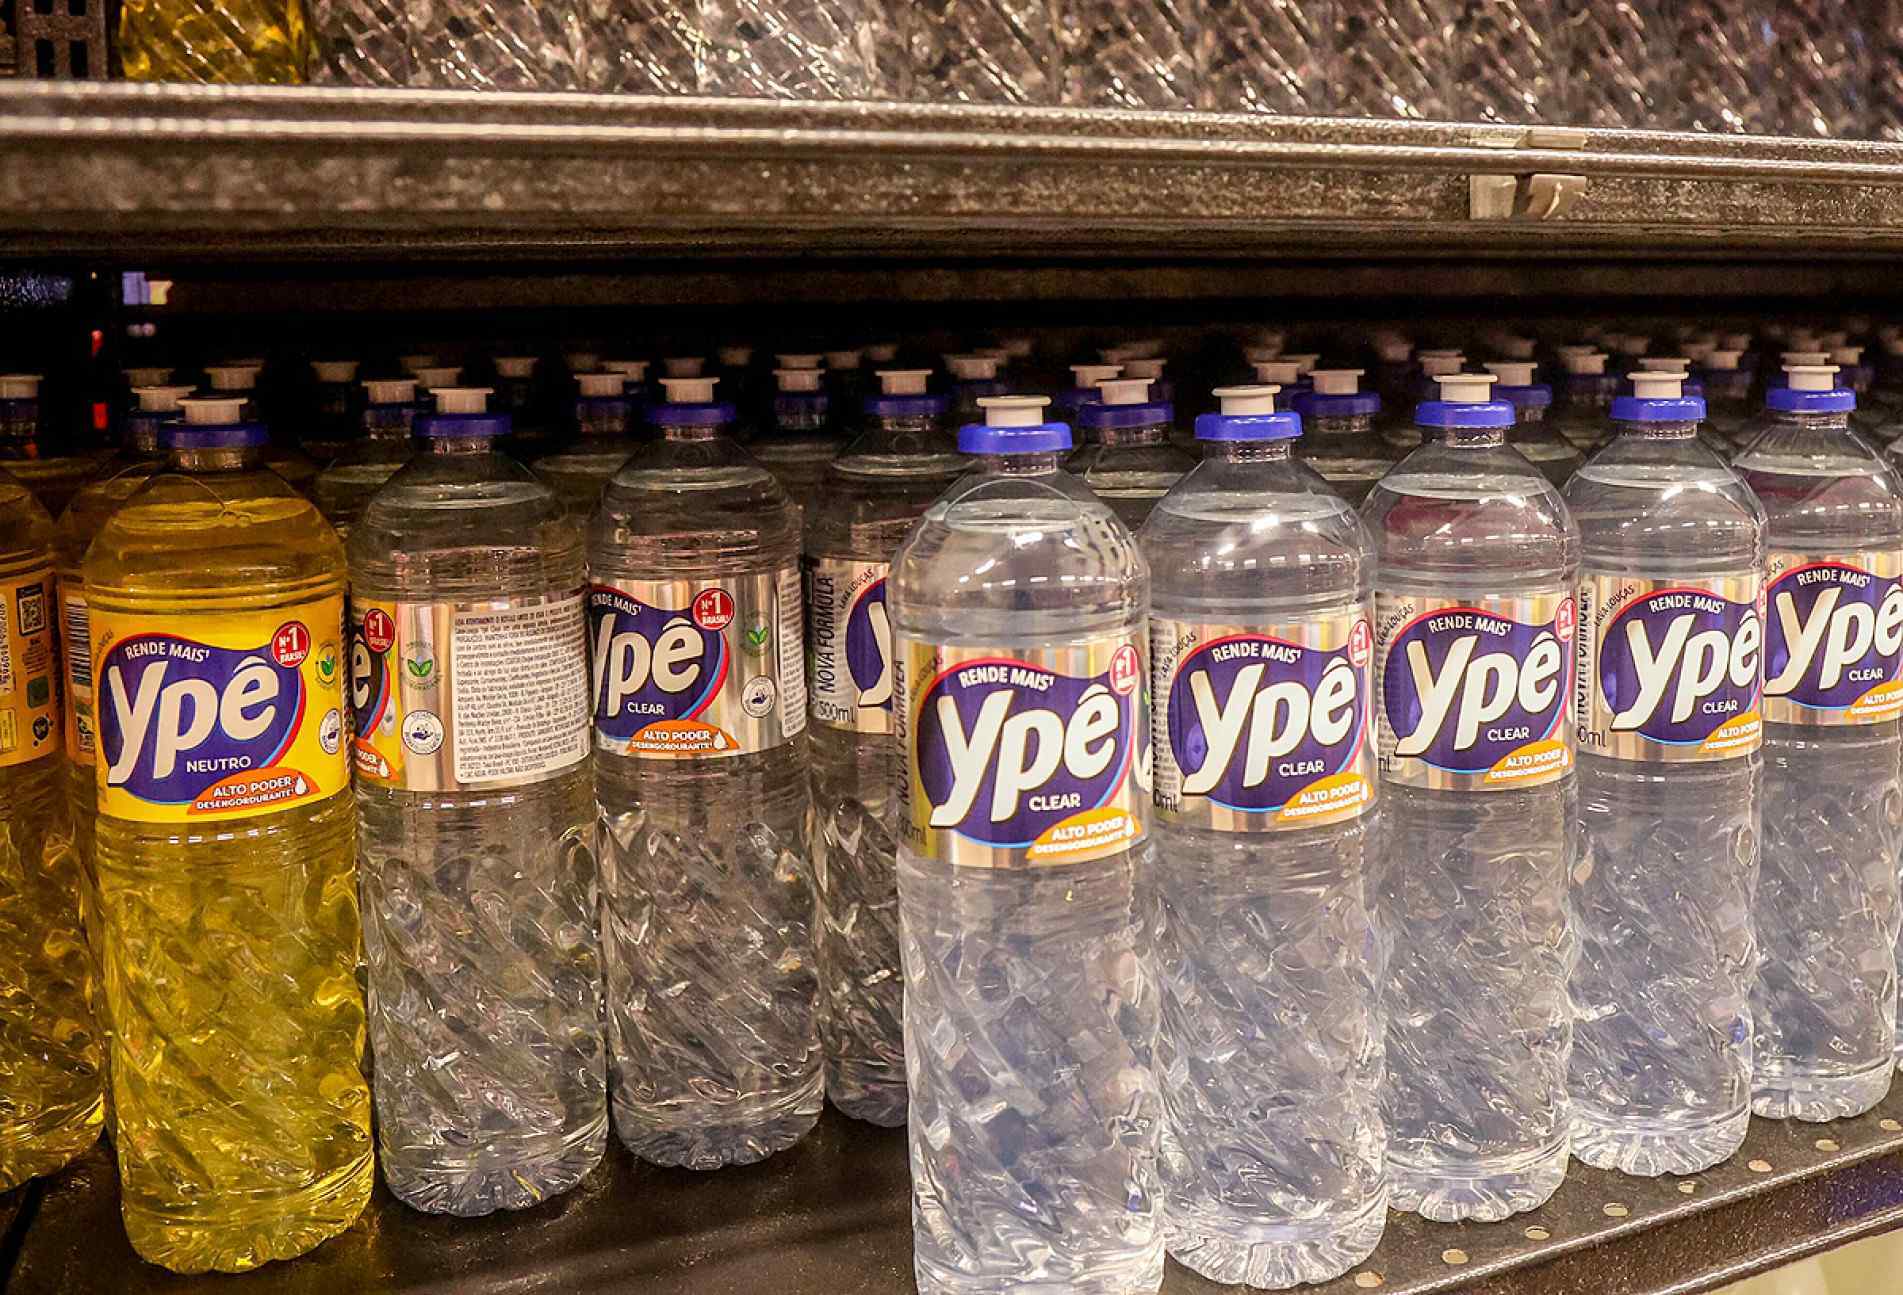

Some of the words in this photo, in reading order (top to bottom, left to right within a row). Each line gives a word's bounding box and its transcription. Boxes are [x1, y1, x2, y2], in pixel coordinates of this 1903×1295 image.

[1796, 568, 1838, 586] RENDE
[1648, 595, 1692, 613] RENDE
[1428, 615, 1473, 633] RENDE
[124, 641, 166, 660] RENDE
[1212, 642, 1260, 663] RENDE
[816, 652, 836, 693] NOVA
[958, 665, 1008, 688] RENDE
[1848, 667, 1884, 682] CLEAR
[627, 701, 665, 716] CLEAR
[1702, 700, 1739, 714] CLEAR
[643, 730, 670, 741] ALTO
[672, 730, 712, 741] PODER
[1487, 726, 1530, 742] CLEAR
[186, 755, 252, 773] NEUTRO
[1279, 760, 1325, 777] CLEAR
[1505, 756, 1533, 768] ALTO
[213, 784, 247, 797] ALTO
[250, 776, 292, 793] PODER
[1028, 793, 1081, 812] CLEAR
[1300, 790, 1329, 803] ALTO
[1052, 825, 1086, 841] ALTO
